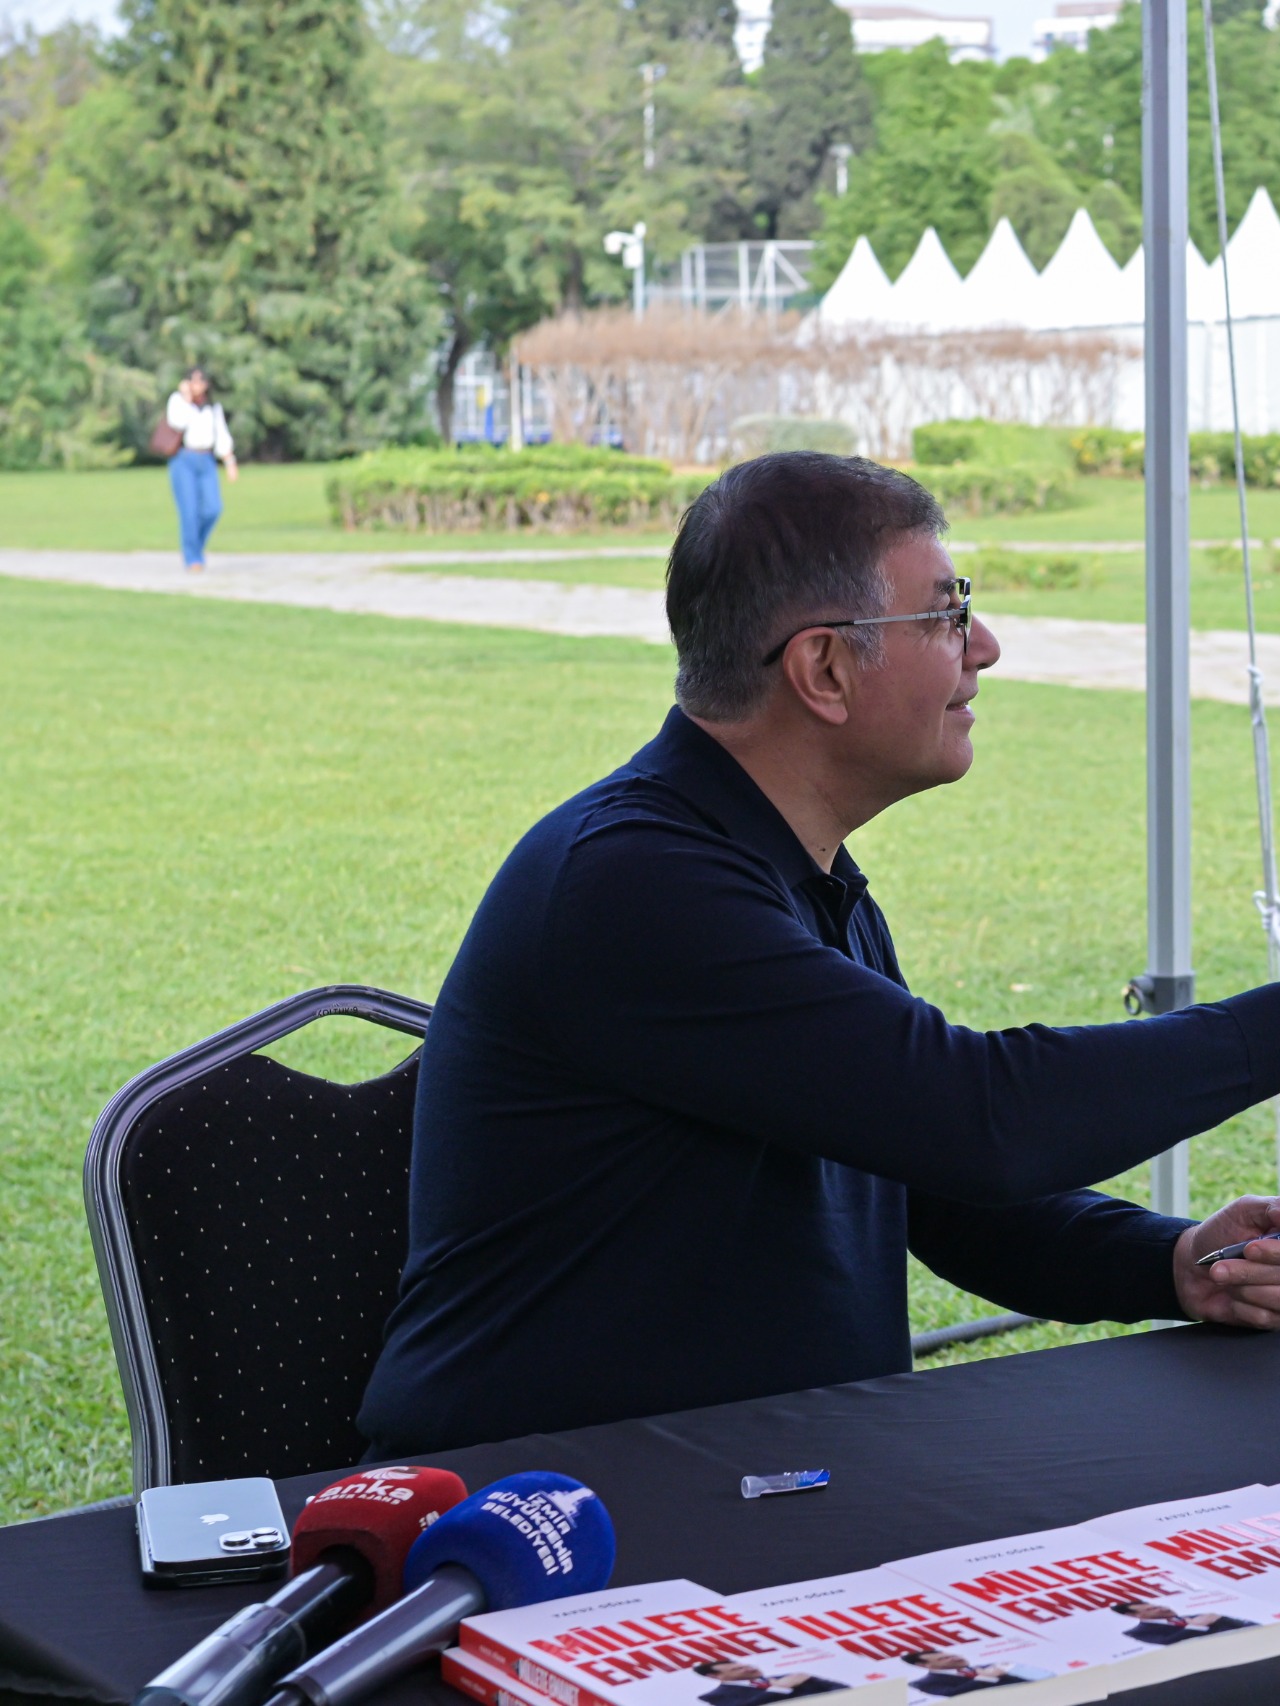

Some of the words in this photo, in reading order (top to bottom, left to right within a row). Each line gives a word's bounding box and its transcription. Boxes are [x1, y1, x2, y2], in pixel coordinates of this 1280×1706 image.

[319, 1480, 414, 1502] anka
[949, 1551, 1161, 1603] MİLLETE
[997, 1571, 1200, 1625] EMANET
[527, 1604, 760, 1663] MİLLETE
[776, 1594, 962, 1640] İLLETE
[834, 1616, 1004, 1661] ANET
[575, 1626, 803, 1687] EMANET
